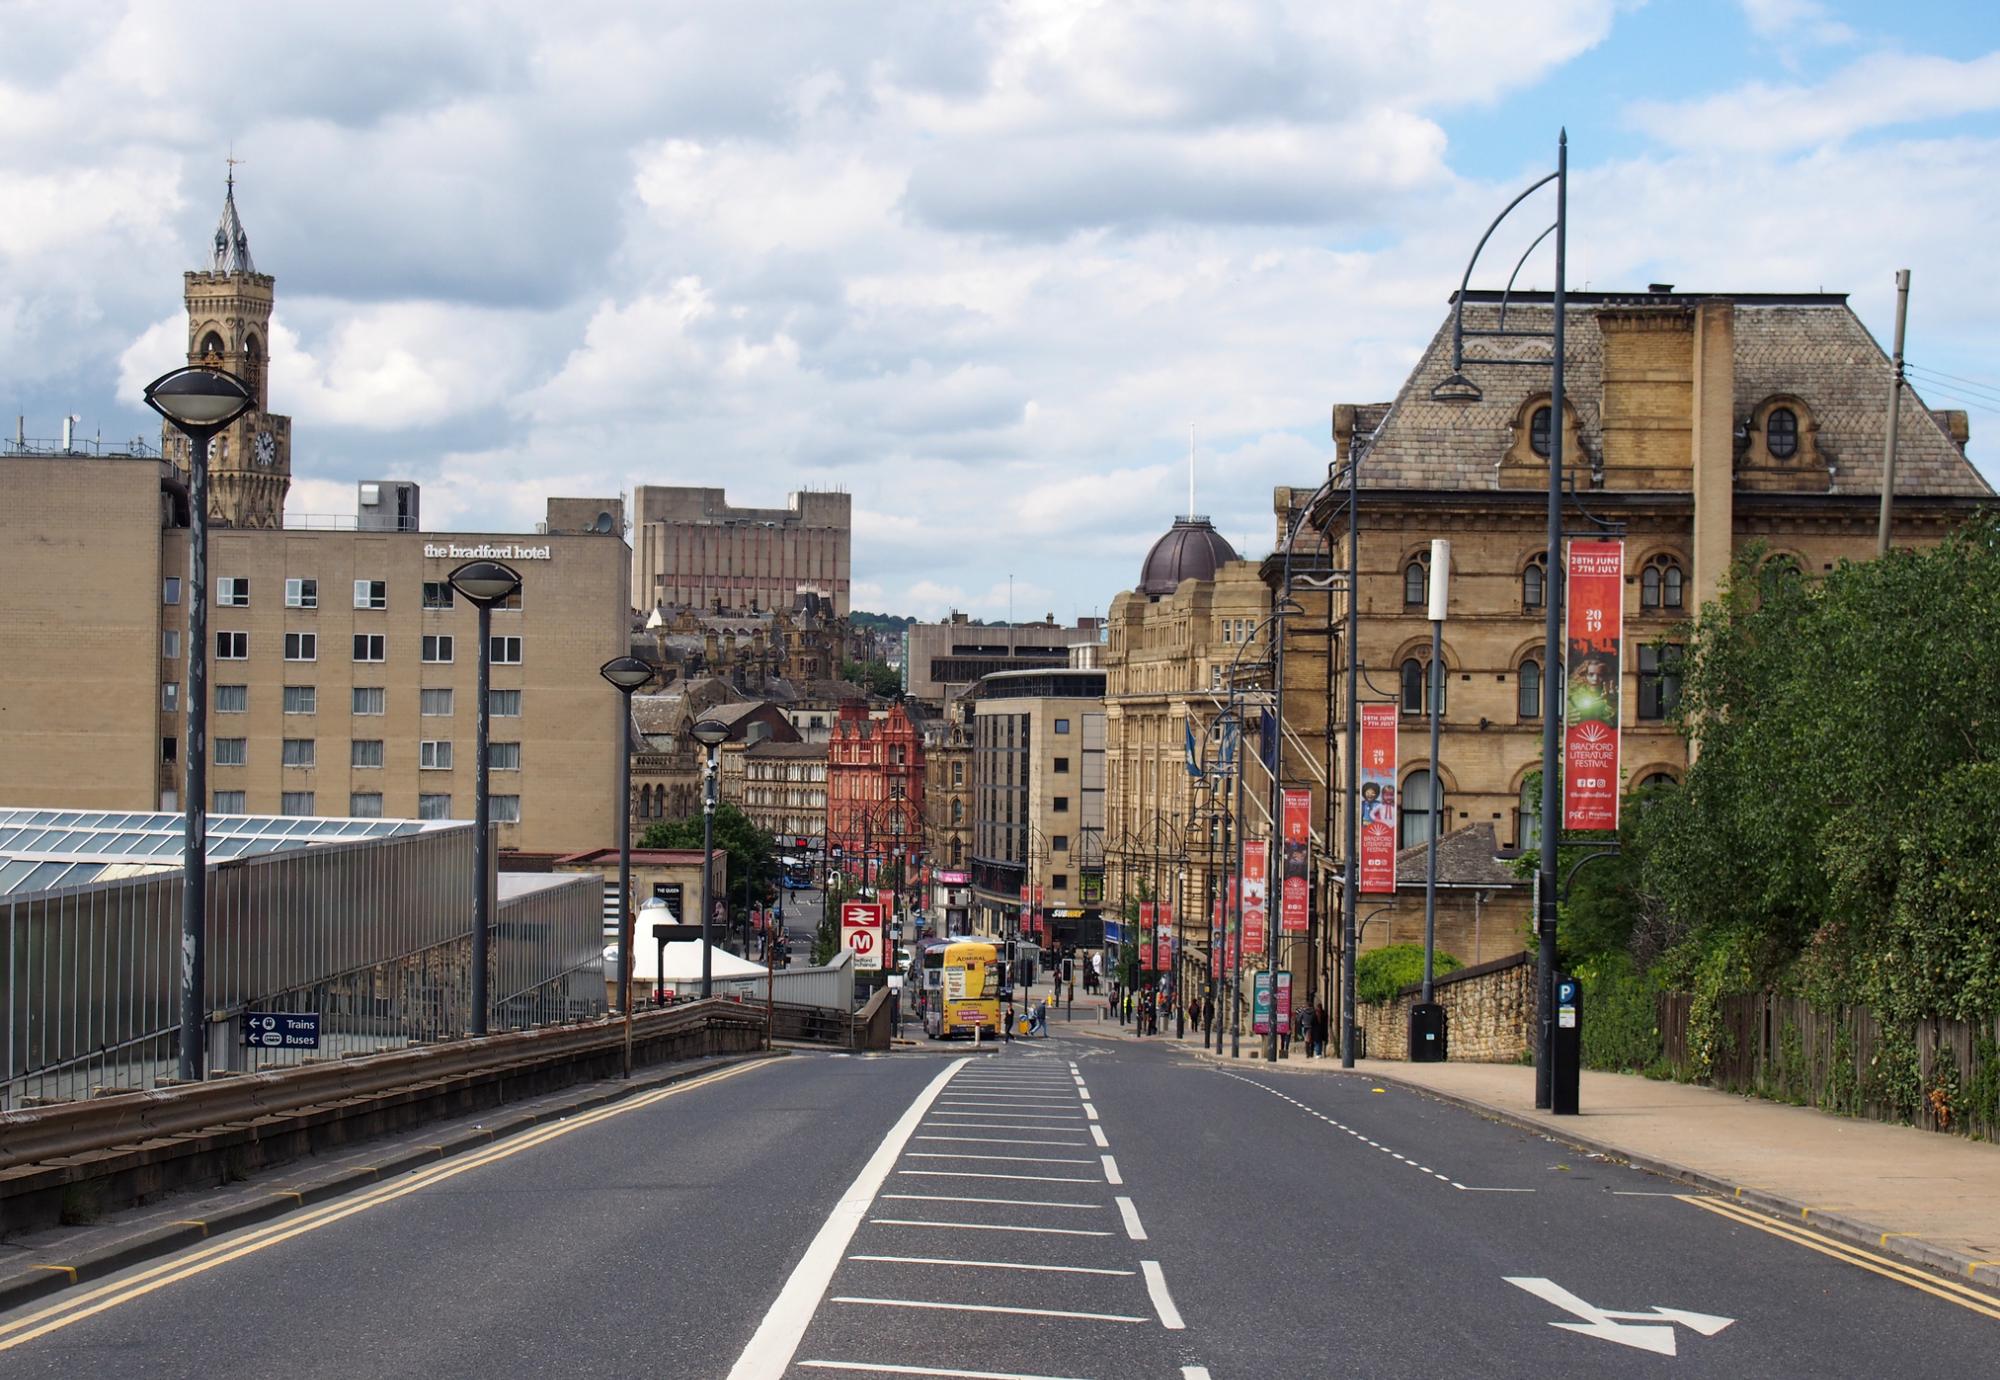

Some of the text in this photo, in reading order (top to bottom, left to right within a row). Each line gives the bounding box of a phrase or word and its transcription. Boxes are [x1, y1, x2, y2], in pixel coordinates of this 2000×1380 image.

[424, 544, 551, 560] the bradford hotel
[1571, 556, 1620, 565] 28TH JUNE
[1578, 565, 1595, 573] 7TH
[1597, 565, 1618, 574] JULY
[1585, 609, 1602, 620] 20
[1587, 621, 1602, 632] 19
[1570, 742, 1614, 751] BRADFORD
[1569, 751, 1614, 760] LITERATURE
[1575, 759, 1608, 768] FESTIVAL
[852, 934, 871, 949] M
[1561, 984, 1571, 1000] P
[286, 1019, 315, 1030] Trains
[286, 1034, 315, 1045] Buses
